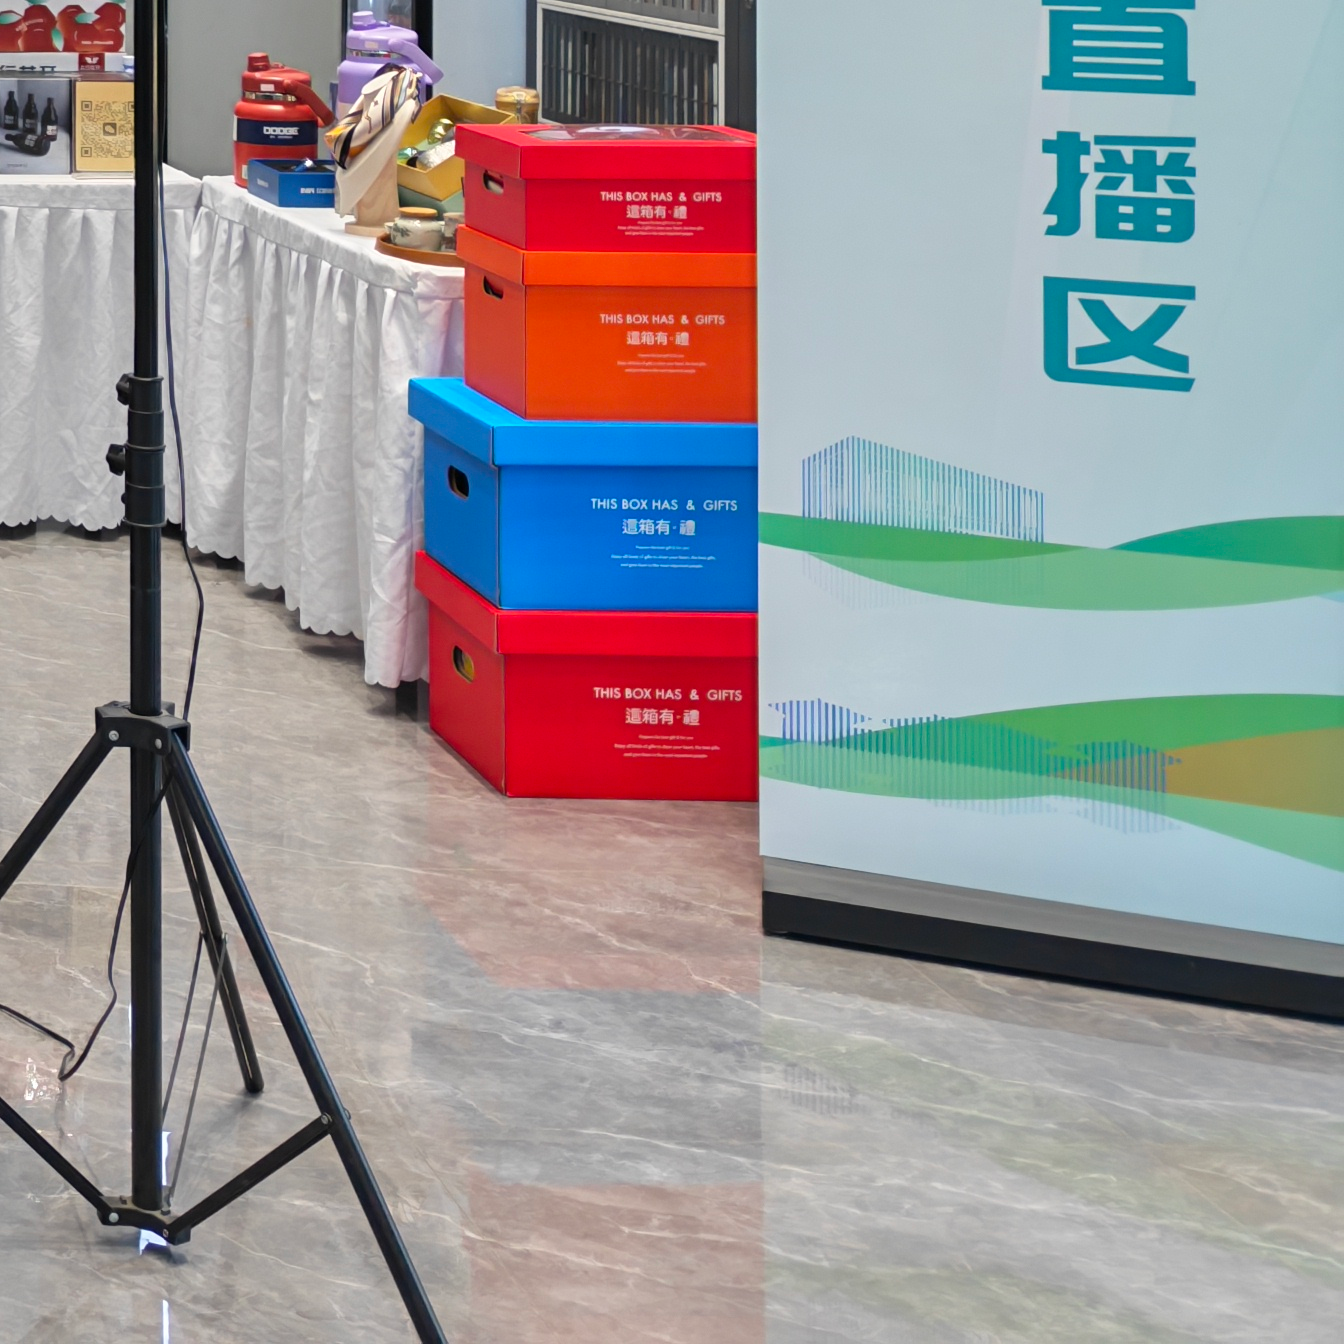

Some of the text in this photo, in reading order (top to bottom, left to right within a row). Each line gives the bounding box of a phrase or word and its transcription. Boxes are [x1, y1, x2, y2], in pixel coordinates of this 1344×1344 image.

[600, 191, 722, 202] THIS BOX HAS & GIFTS
[600, 314, 725, 325] THIS BOX HAS & GIFTS
[591, 498, 738, 511] THIS BOX HAS & GIFTS
[593, 687, 742, 701] THIS BOX HAS & GIFTS
